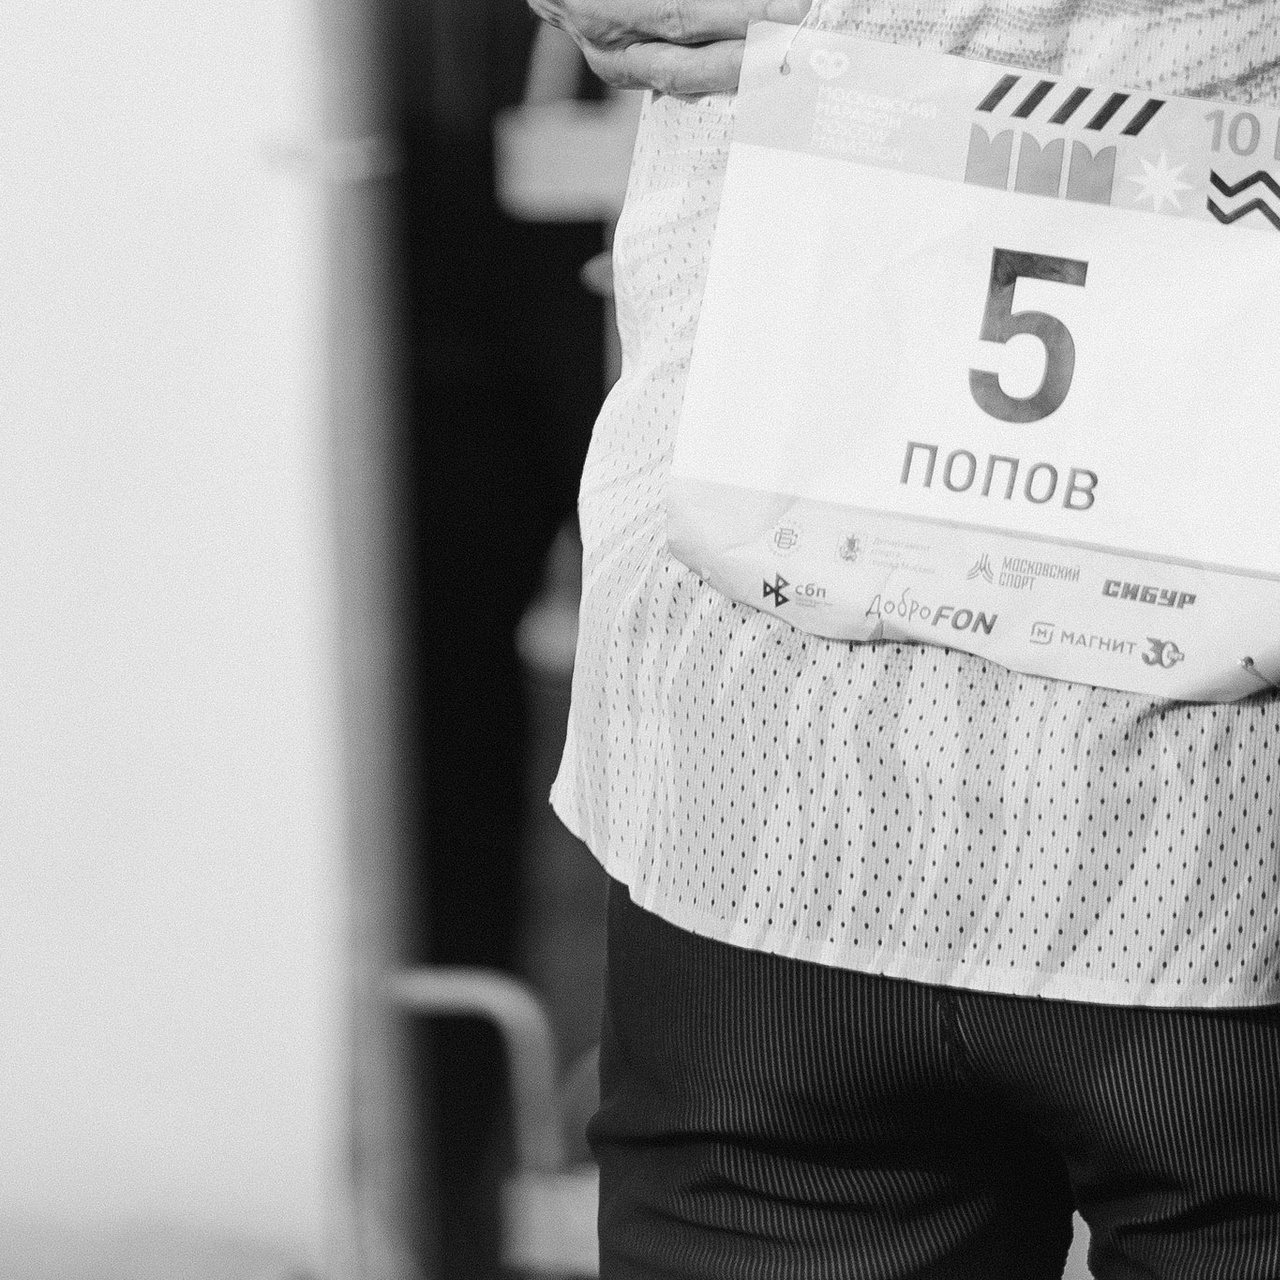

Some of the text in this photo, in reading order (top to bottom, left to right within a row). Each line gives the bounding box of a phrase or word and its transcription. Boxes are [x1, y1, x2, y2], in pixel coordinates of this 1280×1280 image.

[1203, 108, 1262, 158] 10
[968, 246, 1089, 424] 5
[900, 441, 1099, 512] ПОПОВ
[998, 572, 1037, 591] СПОРТ
[1002, 556, 1081, 583] МОСКОВСКИЙ
[795, 582, 828, 598] сбп
[1101, 579, 1197, 610] СИБУР
[1060, 628, 1138, 655] МАГНИТ
